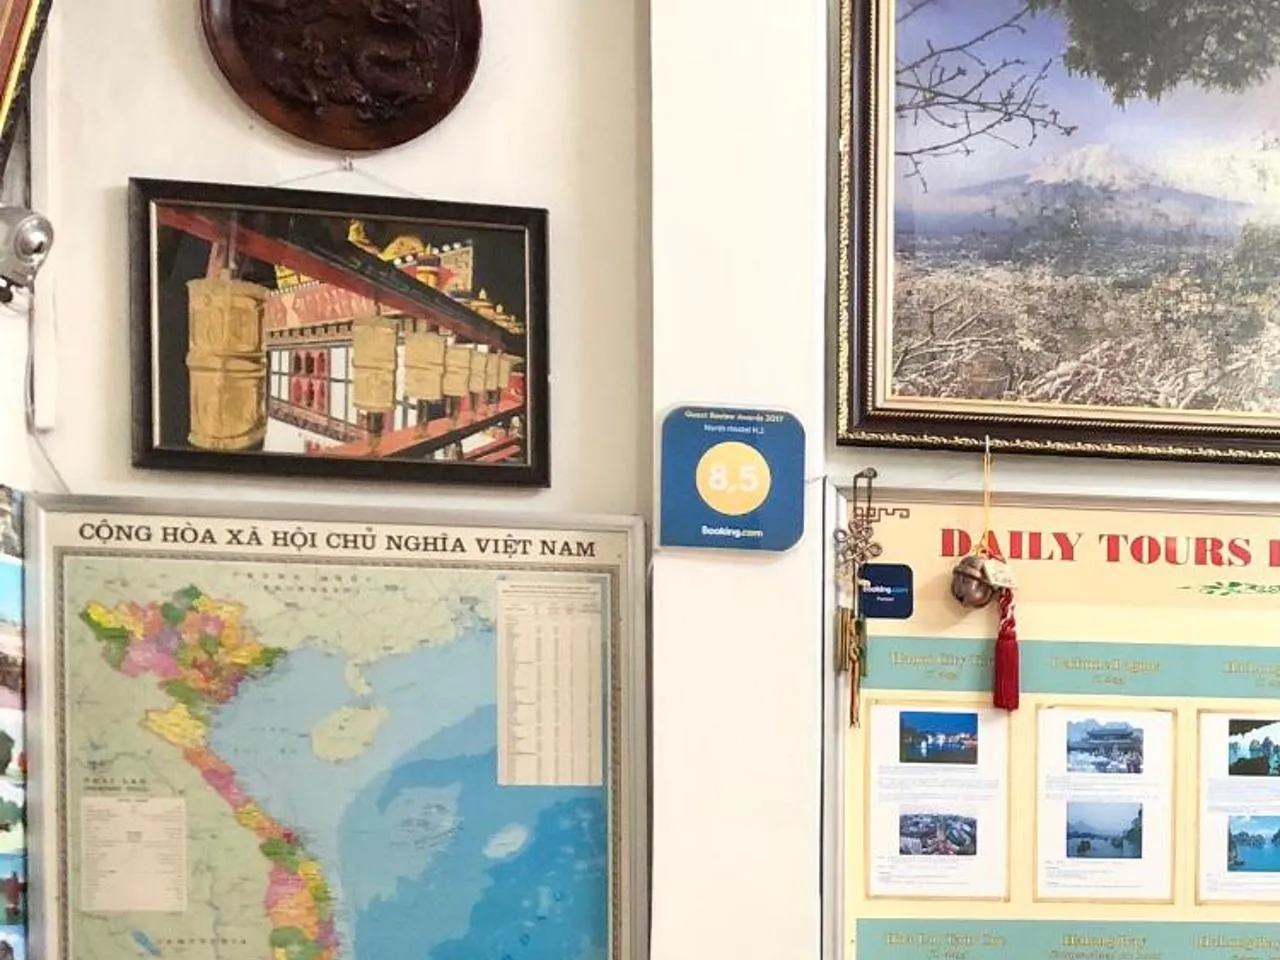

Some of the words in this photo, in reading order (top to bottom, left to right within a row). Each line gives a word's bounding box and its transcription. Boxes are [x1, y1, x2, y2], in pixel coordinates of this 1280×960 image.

[79, 518, 152, 545] CỘNG
[162, 521, 216, 545] HÒA
[271, 526, 318, 551] HỘI
[325, 526, 377, 551] CHỦ
[475, 533, 533, 559] VIỆT
[539, 539, 597, 558] NAM
[701, 525, 763, 538] Booking.com
[939, 528, 1085, 563] DAILY
[1098, 533, 1253, 567] TOURS
